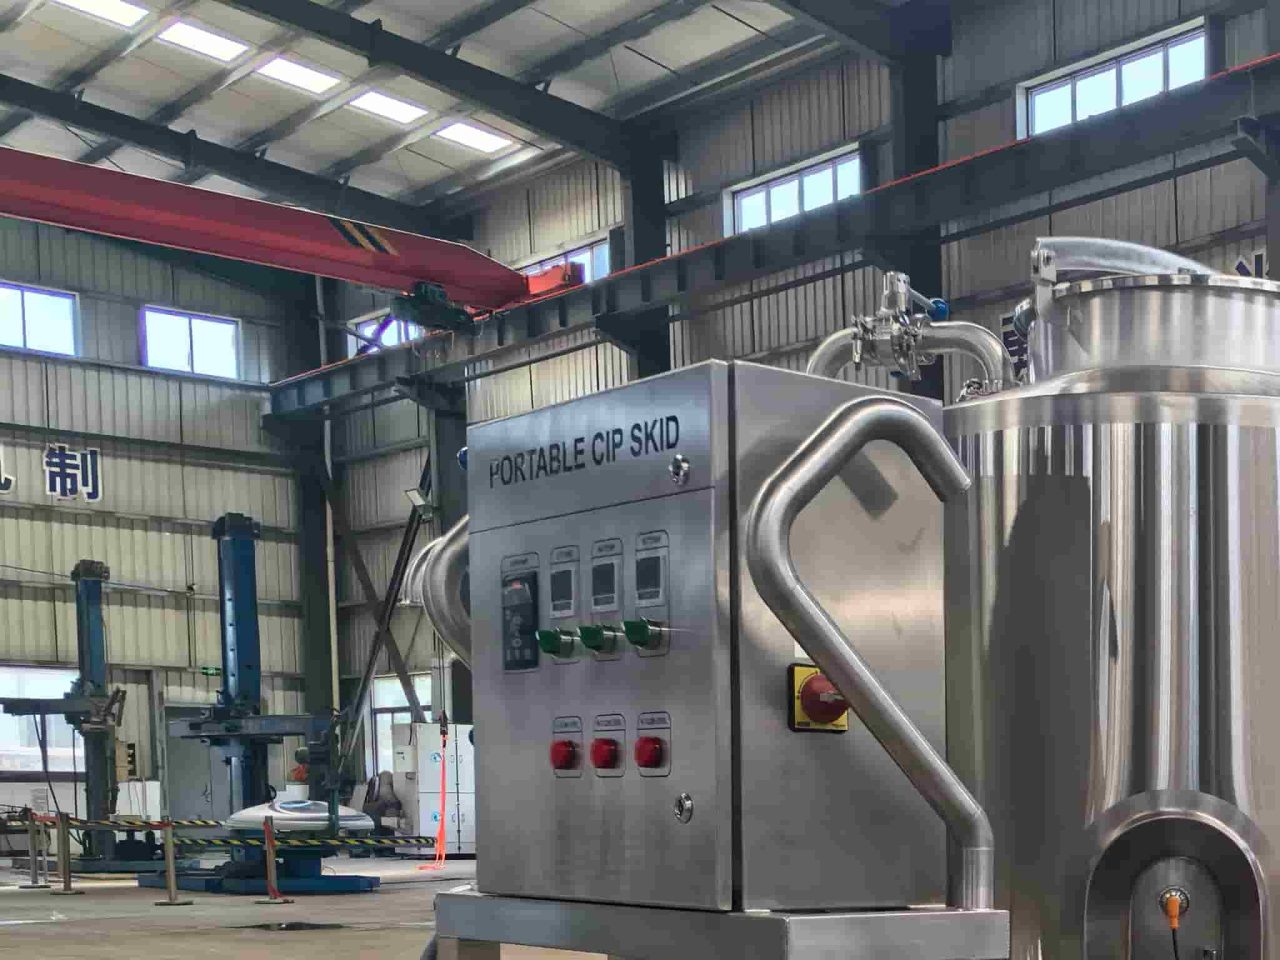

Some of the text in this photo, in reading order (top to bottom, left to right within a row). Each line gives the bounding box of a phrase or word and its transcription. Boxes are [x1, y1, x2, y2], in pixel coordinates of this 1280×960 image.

[0, 443, 103, 502] 制
[489, 415, 680, 488] PORTABLE CIP SKID
